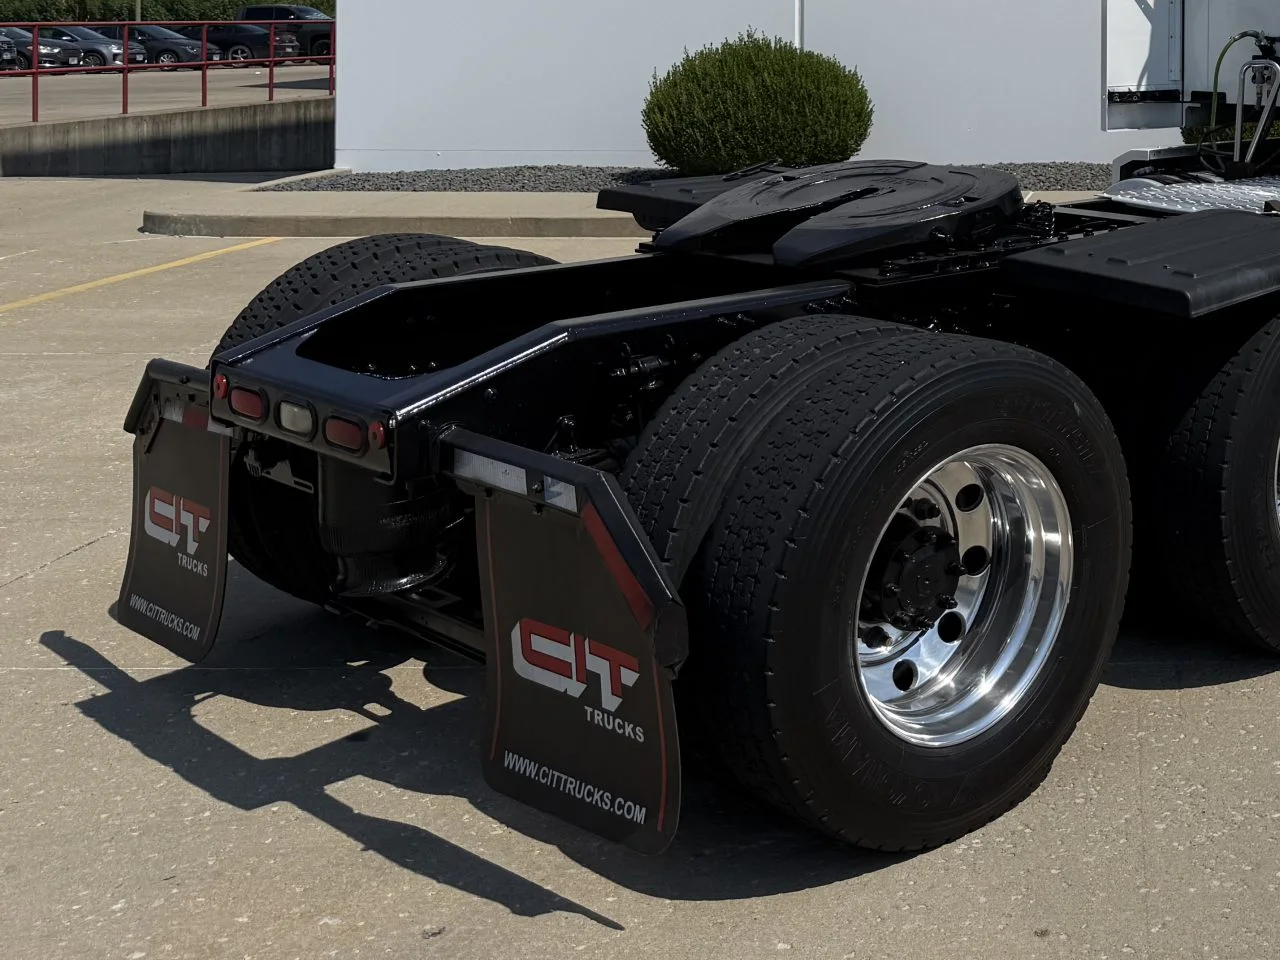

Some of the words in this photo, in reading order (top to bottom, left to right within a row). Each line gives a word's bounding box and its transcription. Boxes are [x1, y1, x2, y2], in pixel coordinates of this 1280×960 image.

[144, 486, 210, 555] CIT
[177, 552, 208, 577] TRUCKS
[130, 593, 200, 641] WWW.CITTRUCKS.COM
[511, 617, 640, 712] CIT
[584, 705, 645, 742] TRUCKS
[504, 750, 647, 824] WWW.CITTRUCKS.COM
